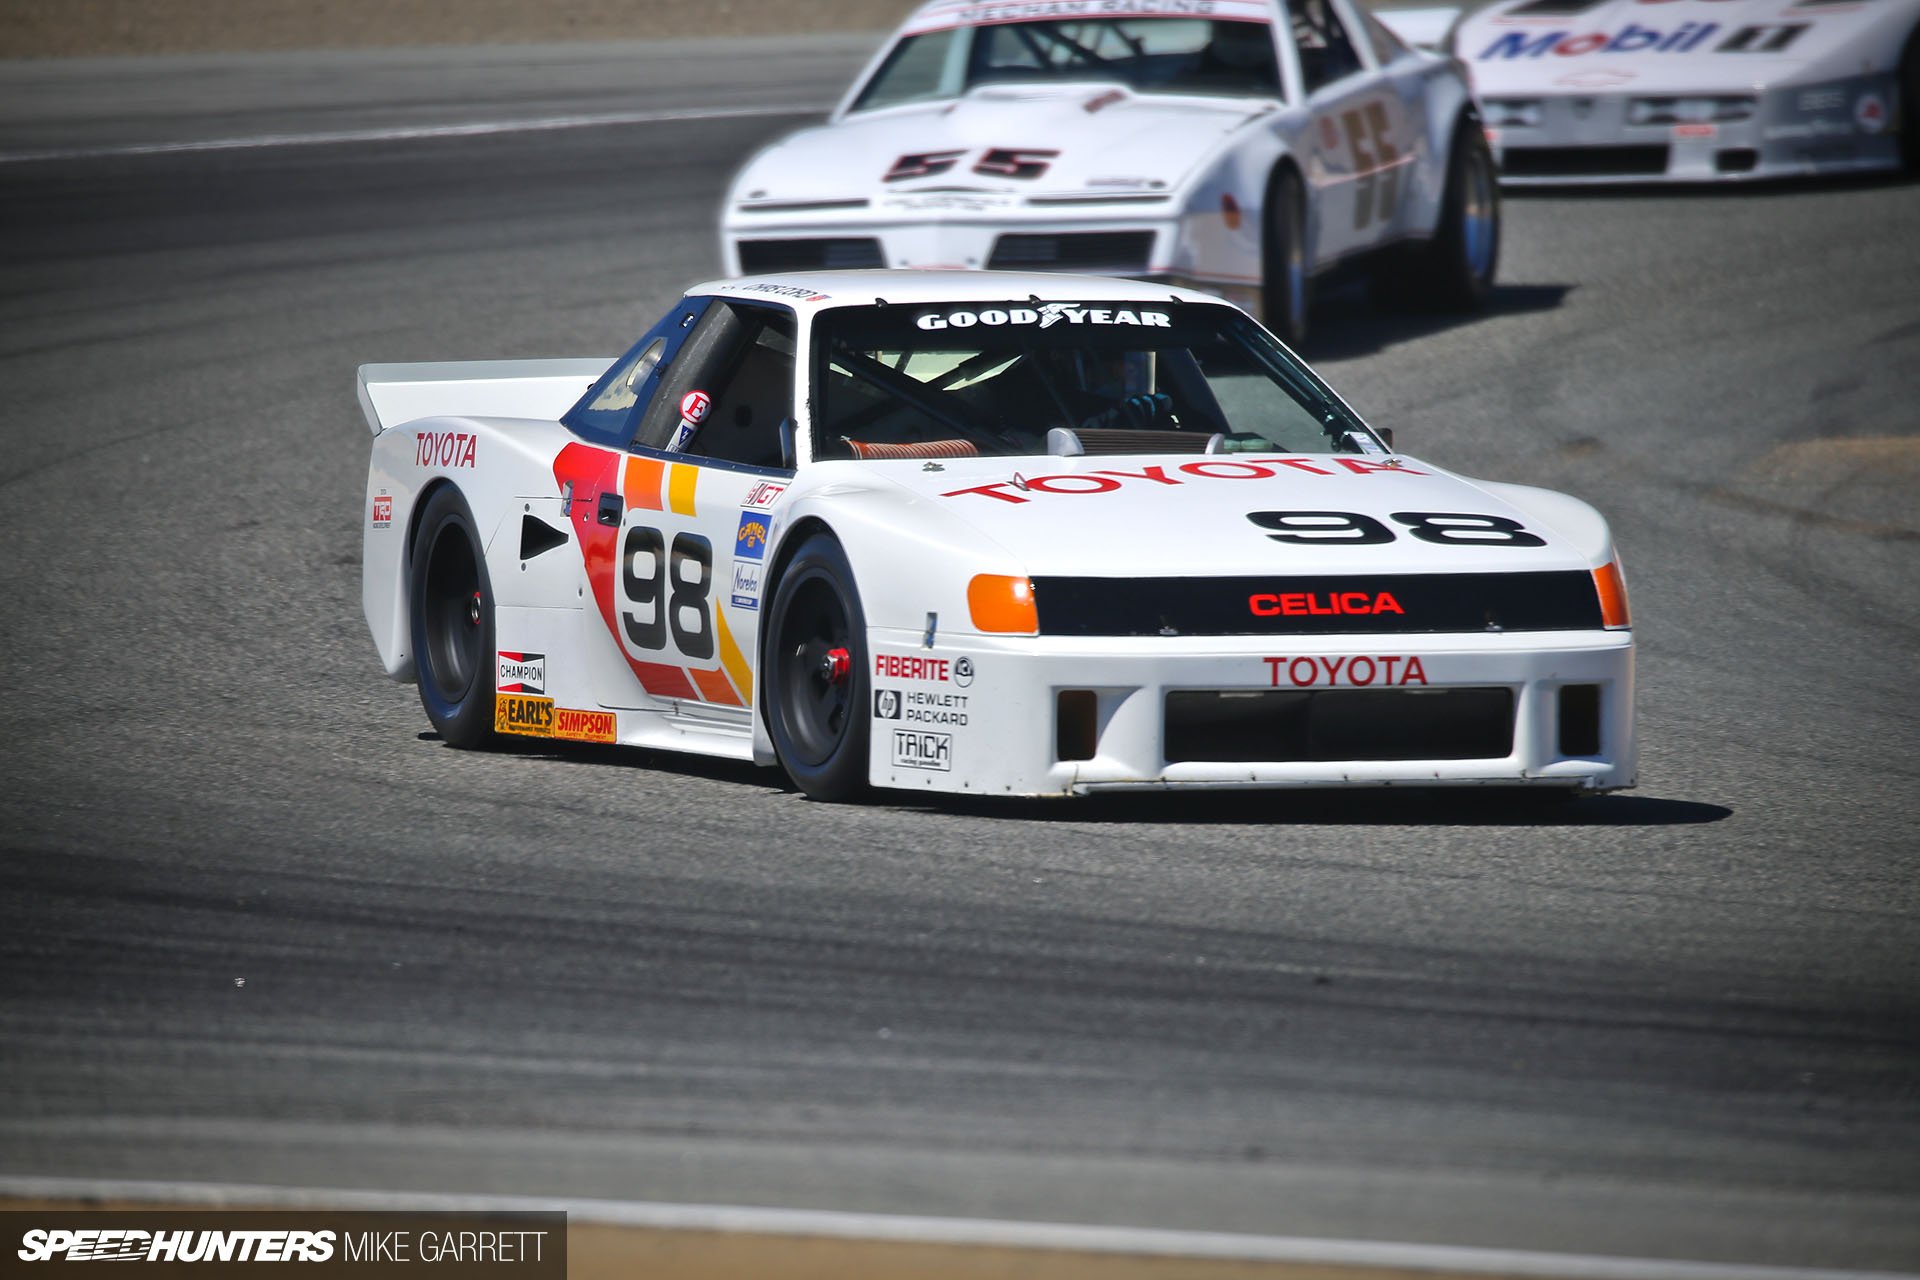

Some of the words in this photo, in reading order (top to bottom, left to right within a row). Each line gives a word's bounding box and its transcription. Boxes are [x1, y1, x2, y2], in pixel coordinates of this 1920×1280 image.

[1479, 22, 1720, 60] Mobil
[881, 148, 1062, 183] 55
[685, 394, 710, 420] E
[415, 432, 477, 468] TOYOTA
[940, 457, 1432, 504] TOYOTA
[757, 485, 784, 505] GT
[738, 521, 766, 545] CAMEL
[1246, 510, 1548, 547] 98
[622, 526, 714, 660] 98
[1249, 592, 1405, 616] CELICA
[500, 664, 543, 681] CHAMPION
[875, 654, 949, 681] FIBERITE
[1263, 656, 1428, 687] TOYOTA
[508, 698, 553, 726] EARL'S
[907, 692, 968, 708] HEWLETT
[558, 711, 612, 734] SIMPSON
[906, 709, 968, 726] PACKARD
[895, 732, 948, 760] TRICK
